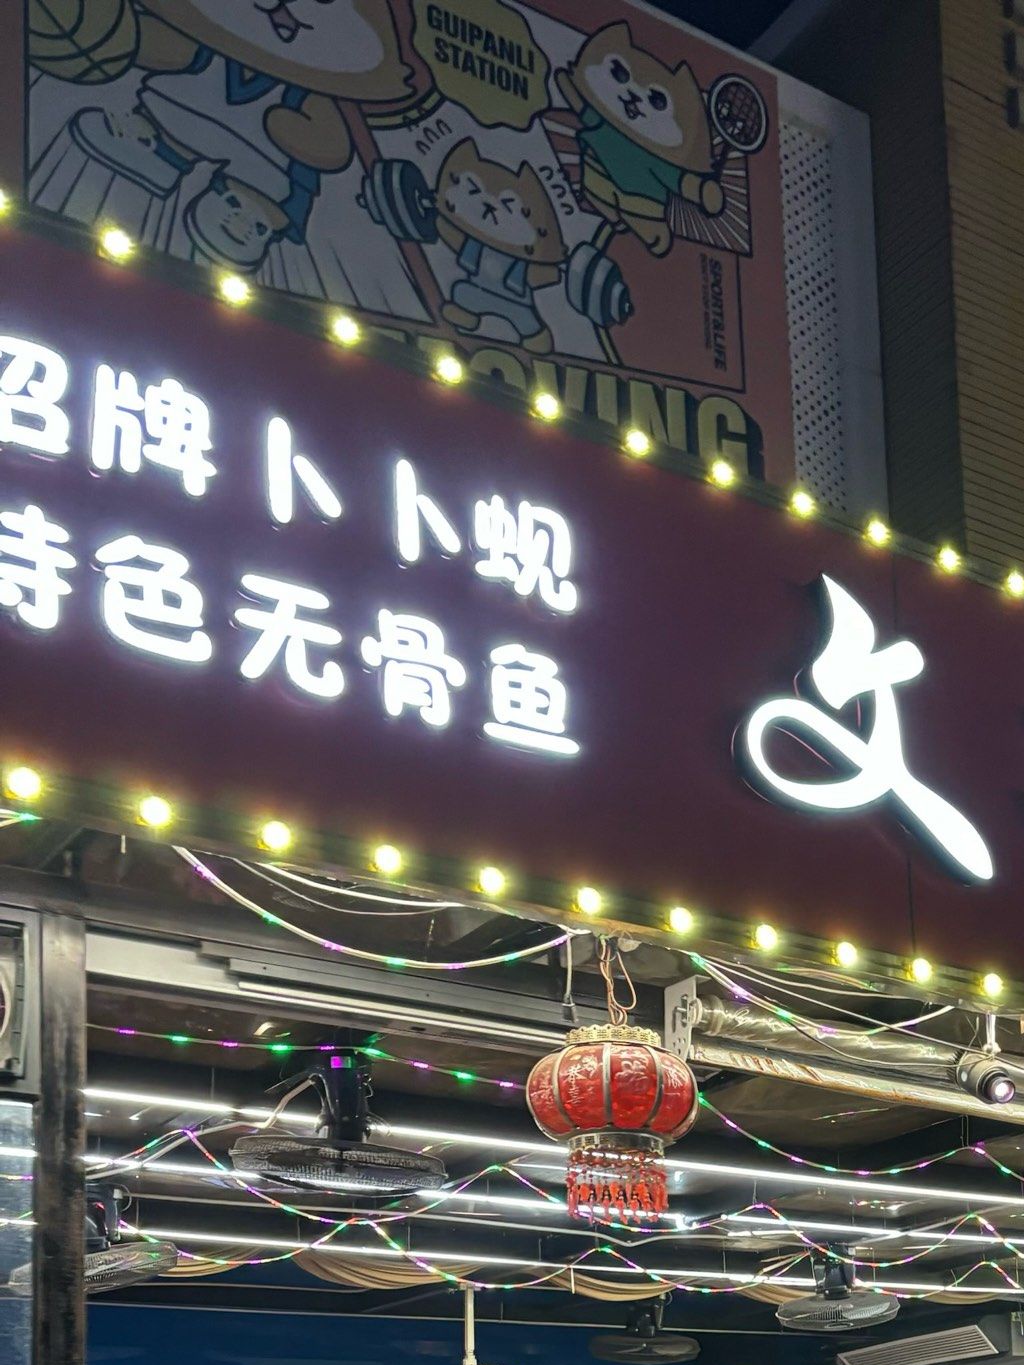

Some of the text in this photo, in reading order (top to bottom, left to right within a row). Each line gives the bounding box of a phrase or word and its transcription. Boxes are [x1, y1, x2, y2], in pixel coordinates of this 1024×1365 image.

[427, 4, 535, 74] GUIPANLI
[434, 36, 529, 101] STATION
[0, 504, 581, 756] 特色无骨鱼
